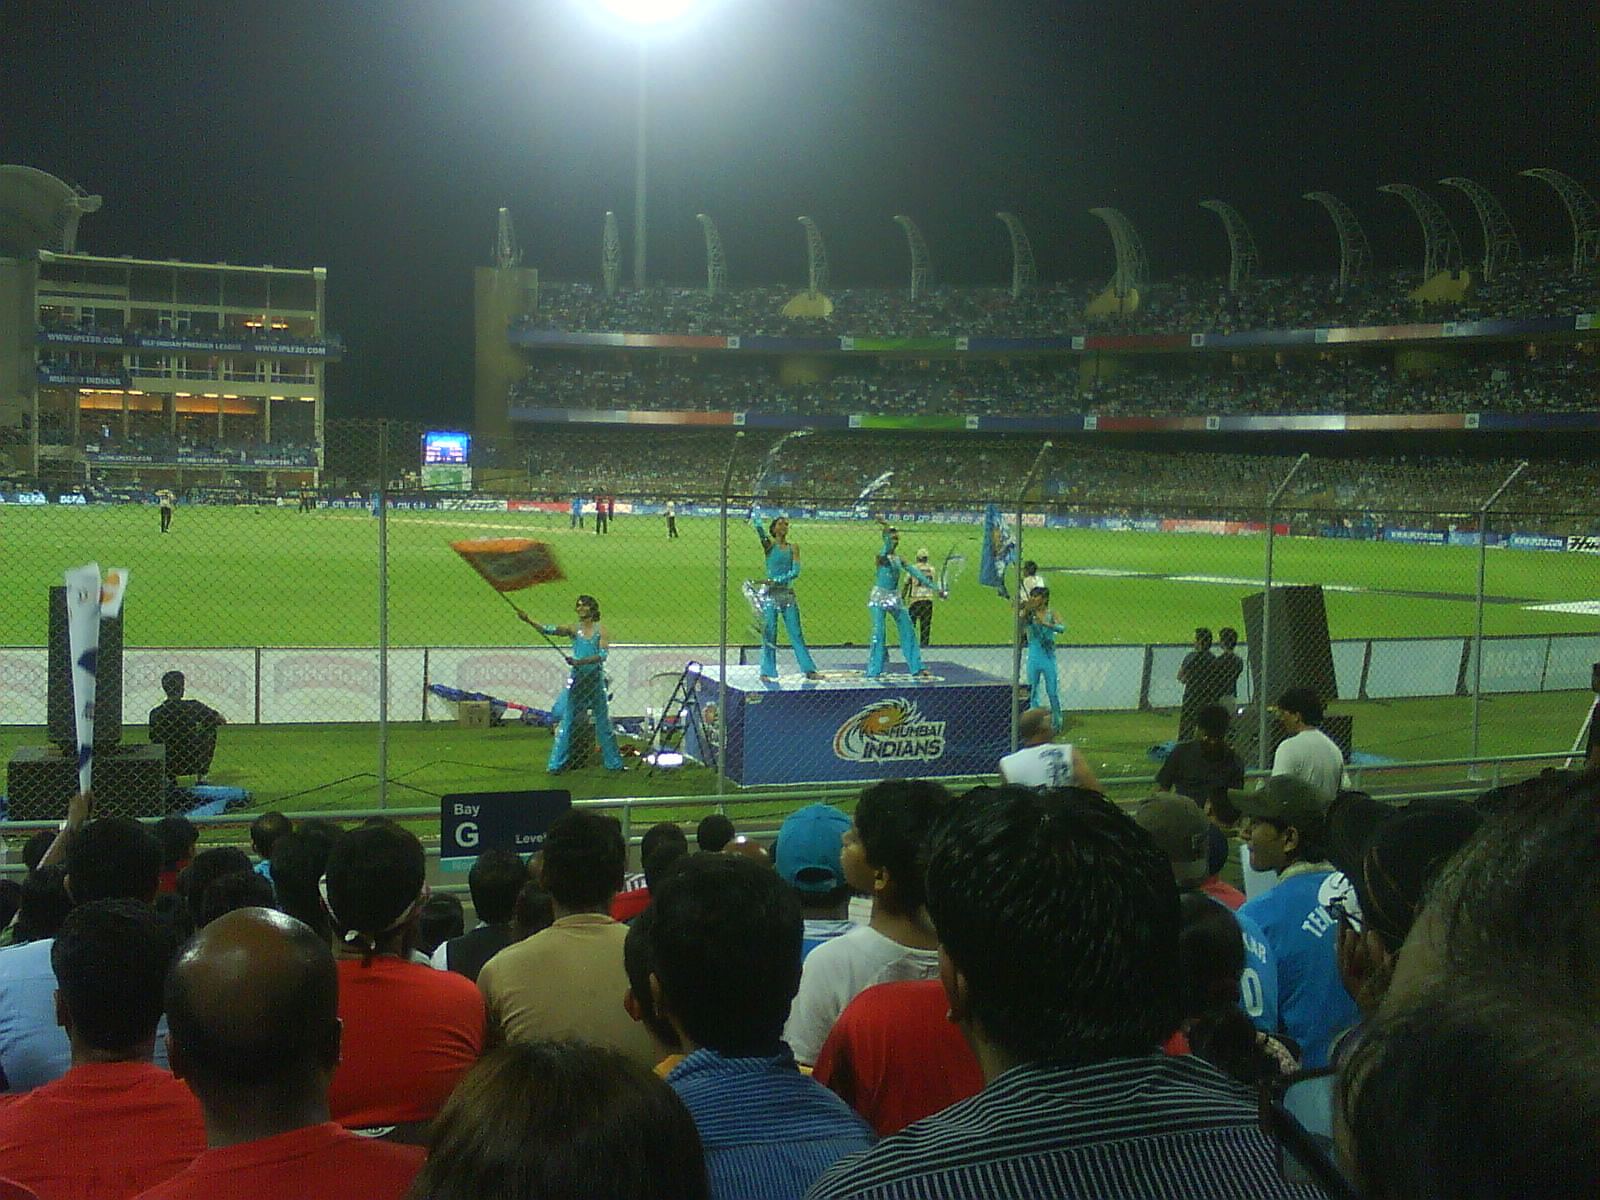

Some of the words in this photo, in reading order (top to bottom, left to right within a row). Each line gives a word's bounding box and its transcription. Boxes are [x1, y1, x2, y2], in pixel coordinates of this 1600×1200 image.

[889, 724, 942, 738] MUMBAI
[862, 740, 941, 758] INDIANS
[453, 803, 480, 817] Bay
[455, 821, 480, 848] G
